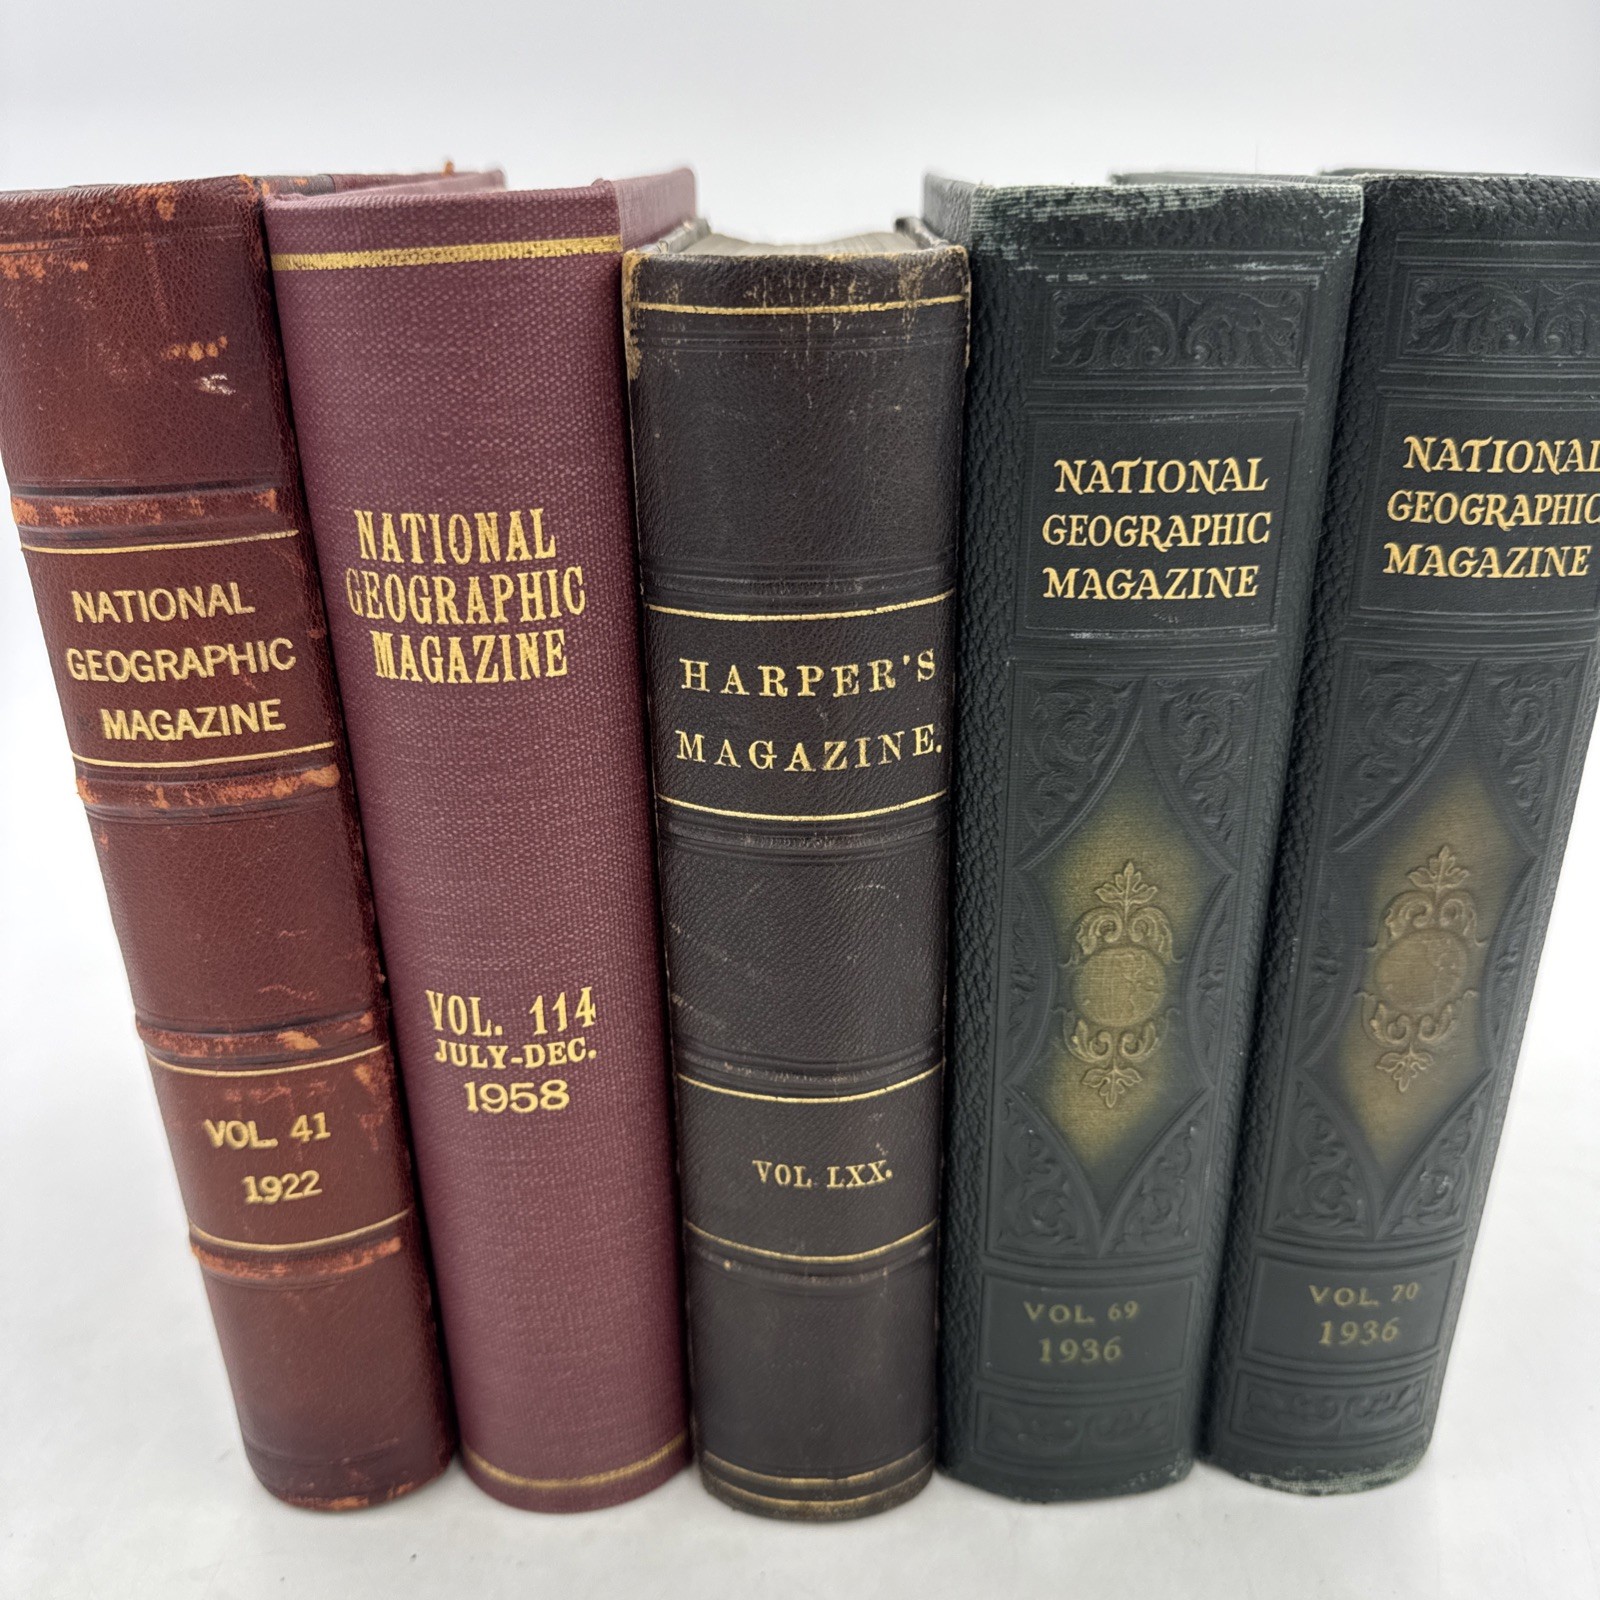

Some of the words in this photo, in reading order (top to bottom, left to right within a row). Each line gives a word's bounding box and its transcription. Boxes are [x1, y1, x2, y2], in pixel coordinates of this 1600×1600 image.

[1053, 457, 1269, 496] NATIONAL
[353, 508, 556, 564] NATIONAL
[1041, 512, 1272, 553] GEOGRAPHIC
[1382, 542, 1592, 579] MAGAZINE
[346, 566, 586, 626] GEOGRAPHIC
[1042, 565, 1260, 601] MAGAZINE
[71, 582, 255, 624] NATIONAL
[66, 638, 296, 683] GEOGRAPHIC
[369, 629, 568, 685] MAGAZINE
[679, 648, 936, 698] HARPER'S
[100, 698, 286, 741] MAGAZINE
[674, 724, 943, 772] MAGAZINE.
[425, 989, 504, 1038] VOL.
[528, 986, 598, 1036] 114
[434, 1037, 598, 1070] JULY-DEC.
[464, 1079, 571, 1114] 1958
[290, 1111, 332, 1142] 41
[242, 1170, 323, 1206] 1922
[827, 1159, 893, 1189] LXX.
[1108, 1301, 1139, 1321] 69
[1391, 1282, 1421, 1302] 70
[1038, 1336, 1123, 1366] 1936
[1318, 1317, 1399, 1347] 1936
